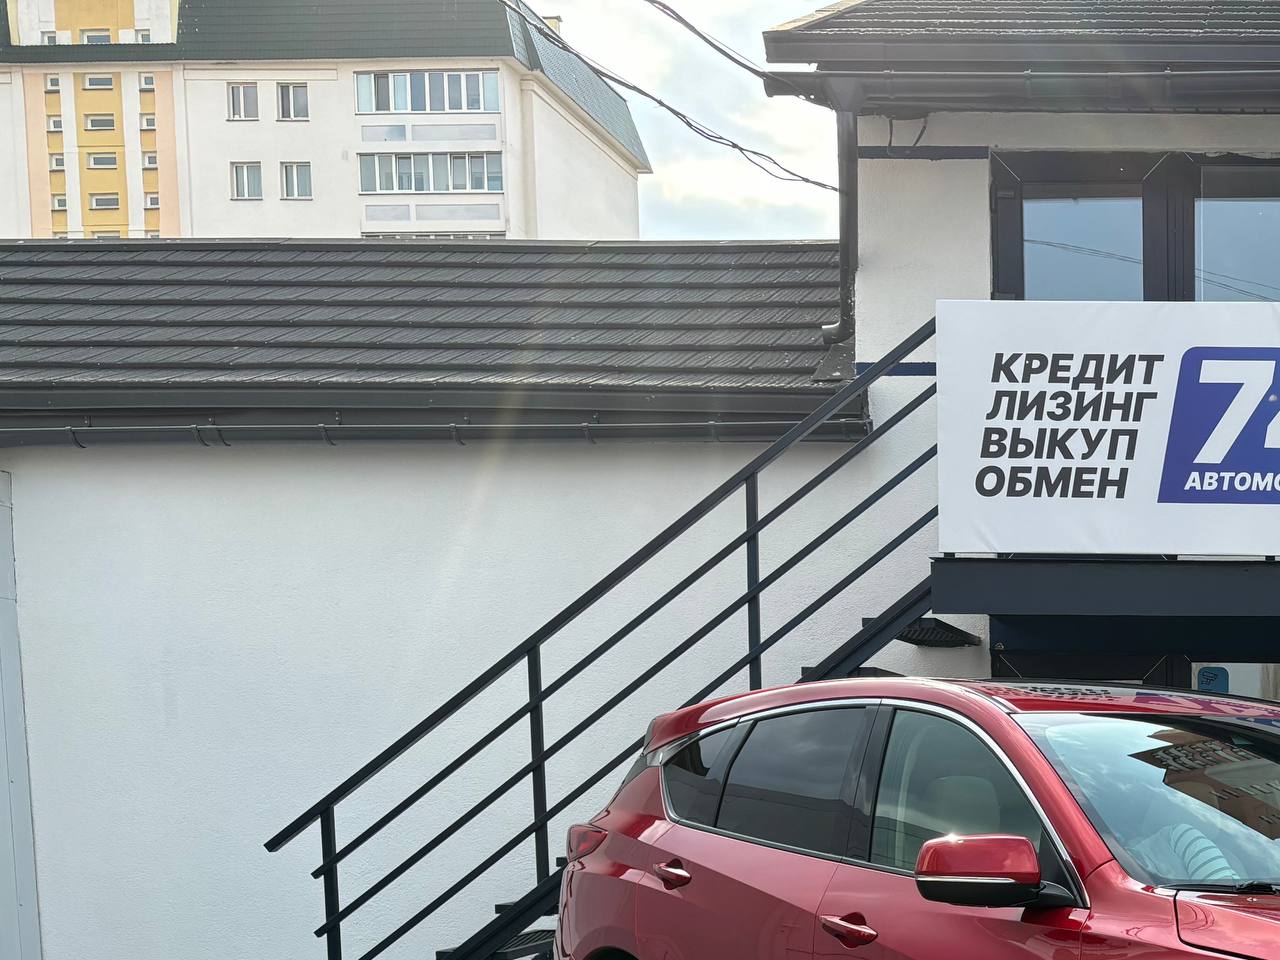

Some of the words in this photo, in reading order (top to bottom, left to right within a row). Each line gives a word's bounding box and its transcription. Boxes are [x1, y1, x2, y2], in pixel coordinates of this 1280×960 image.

[991, 353, 1165, 389] КРЕДИТ
[985, 391, 1158, 422] ЛИЗИНГ
[980, 428, 1139, 460] ВЫКУП
[975, 465, 1129, 499] ОБМЕН
